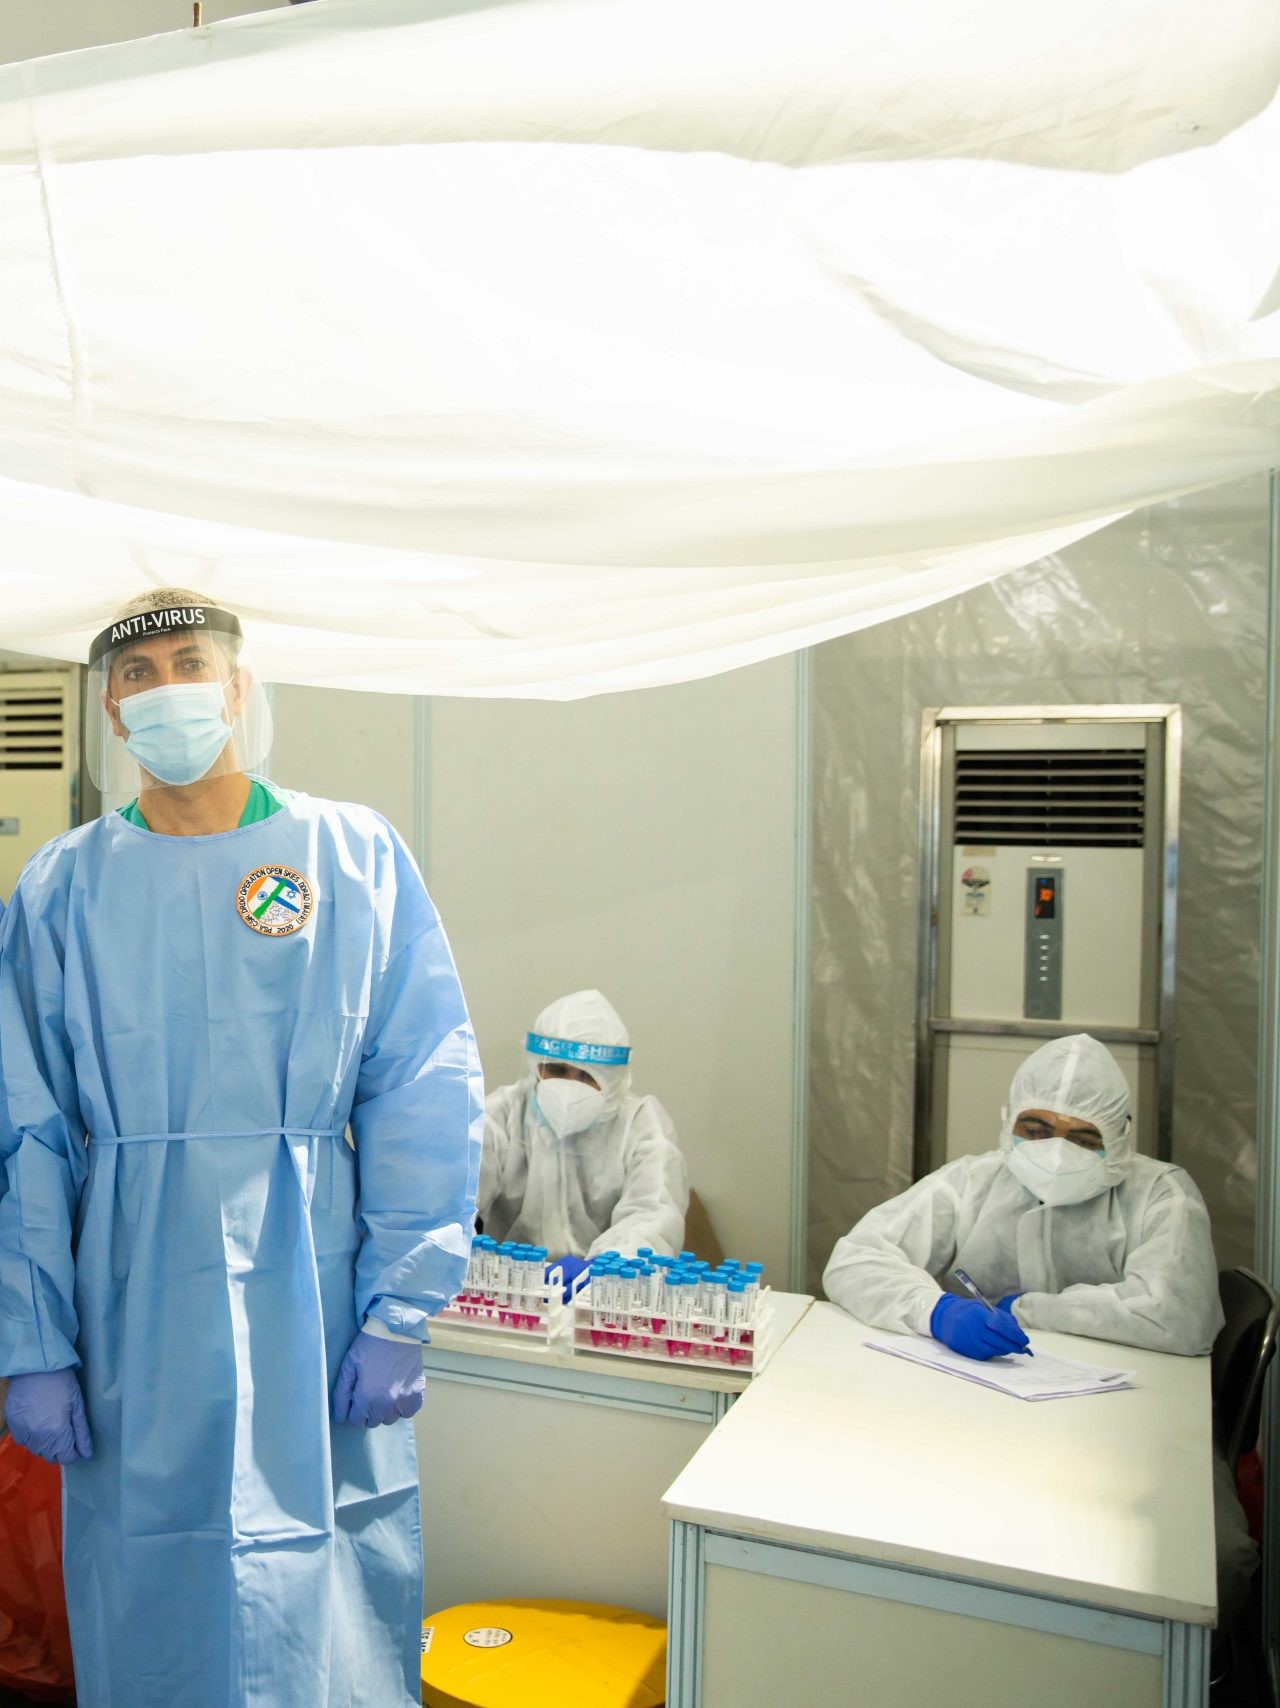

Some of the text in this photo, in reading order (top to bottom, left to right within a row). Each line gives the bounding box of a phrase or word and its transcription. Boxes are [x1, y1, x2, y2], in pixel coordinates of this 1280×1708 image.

[111, 608, 206, 643] ANTI-VIRUS
[142, 629, 161, 637] Protects
[240, 869, 266, 895] OPERATION
[283, 870, 300, 882] SKIES
[260, 925, 272, 933] PSA
